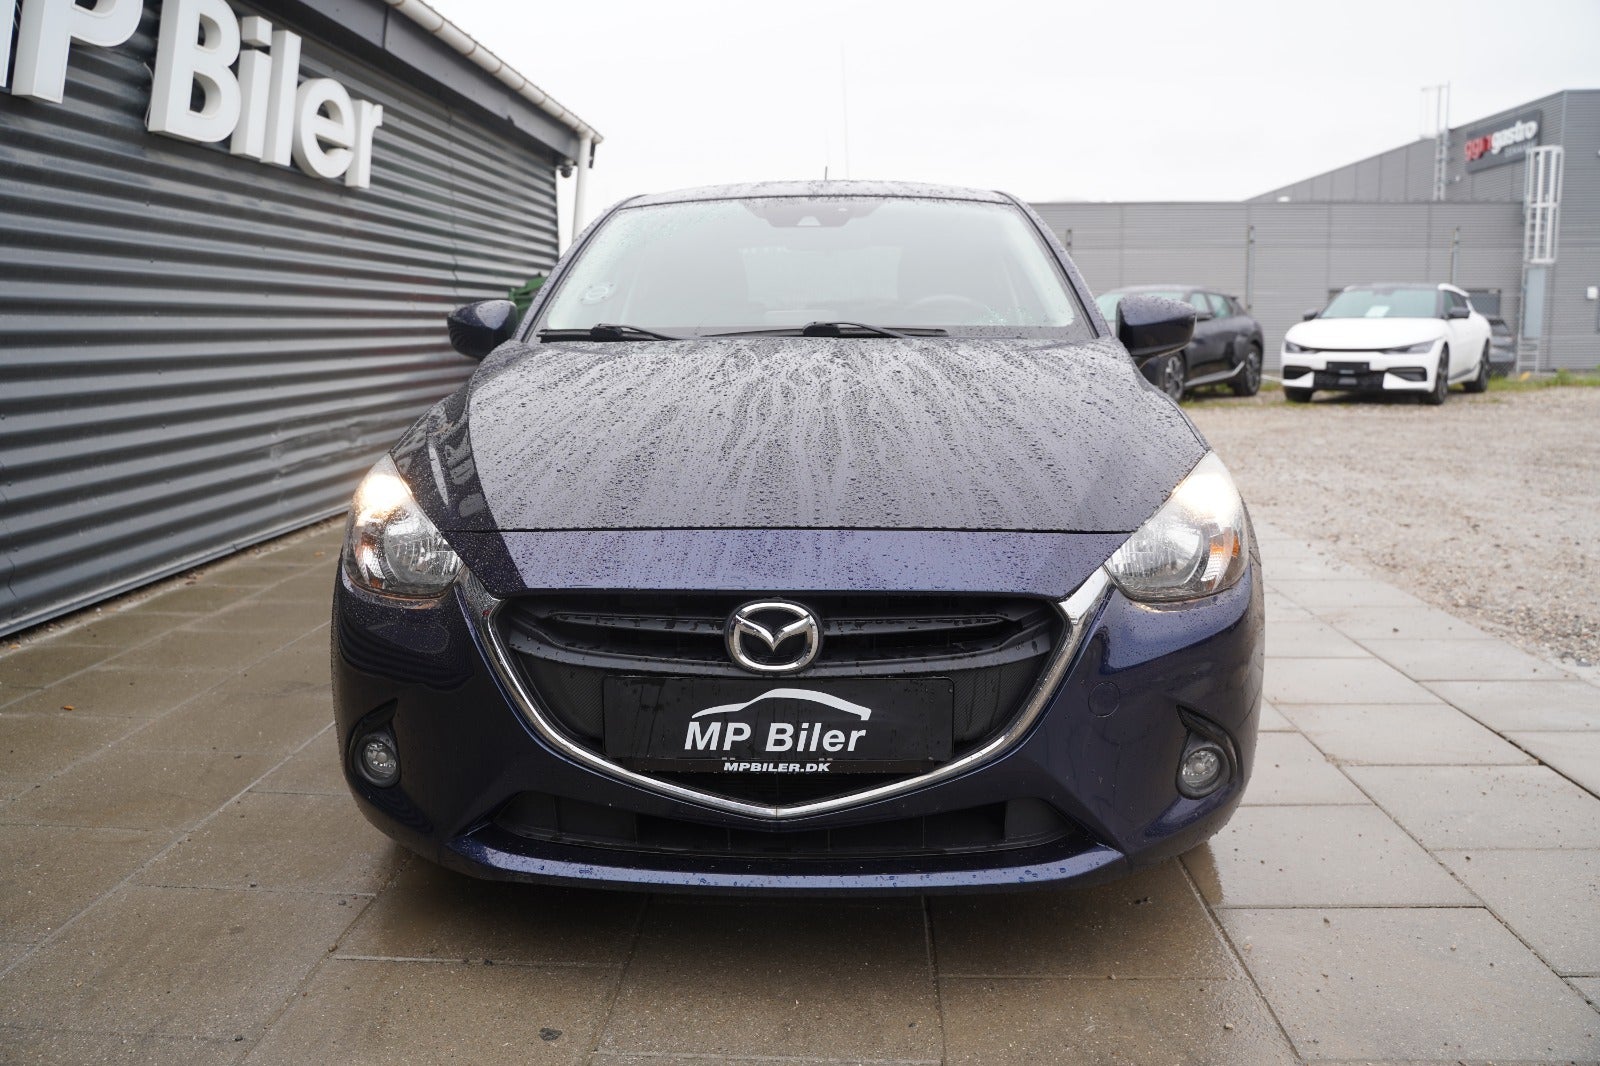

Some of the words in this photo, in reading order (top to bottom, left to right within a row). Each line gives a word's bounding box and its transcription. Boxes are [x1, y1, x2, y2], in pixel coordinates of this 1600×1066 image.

[0, 0, 143, 104] P
[148, 0, 383, 188] Biler
[684, 721, 751, 751] MP
[765, 722, 867, 752] Biler
[723, 762, 831, 772] MPBILER.DK
